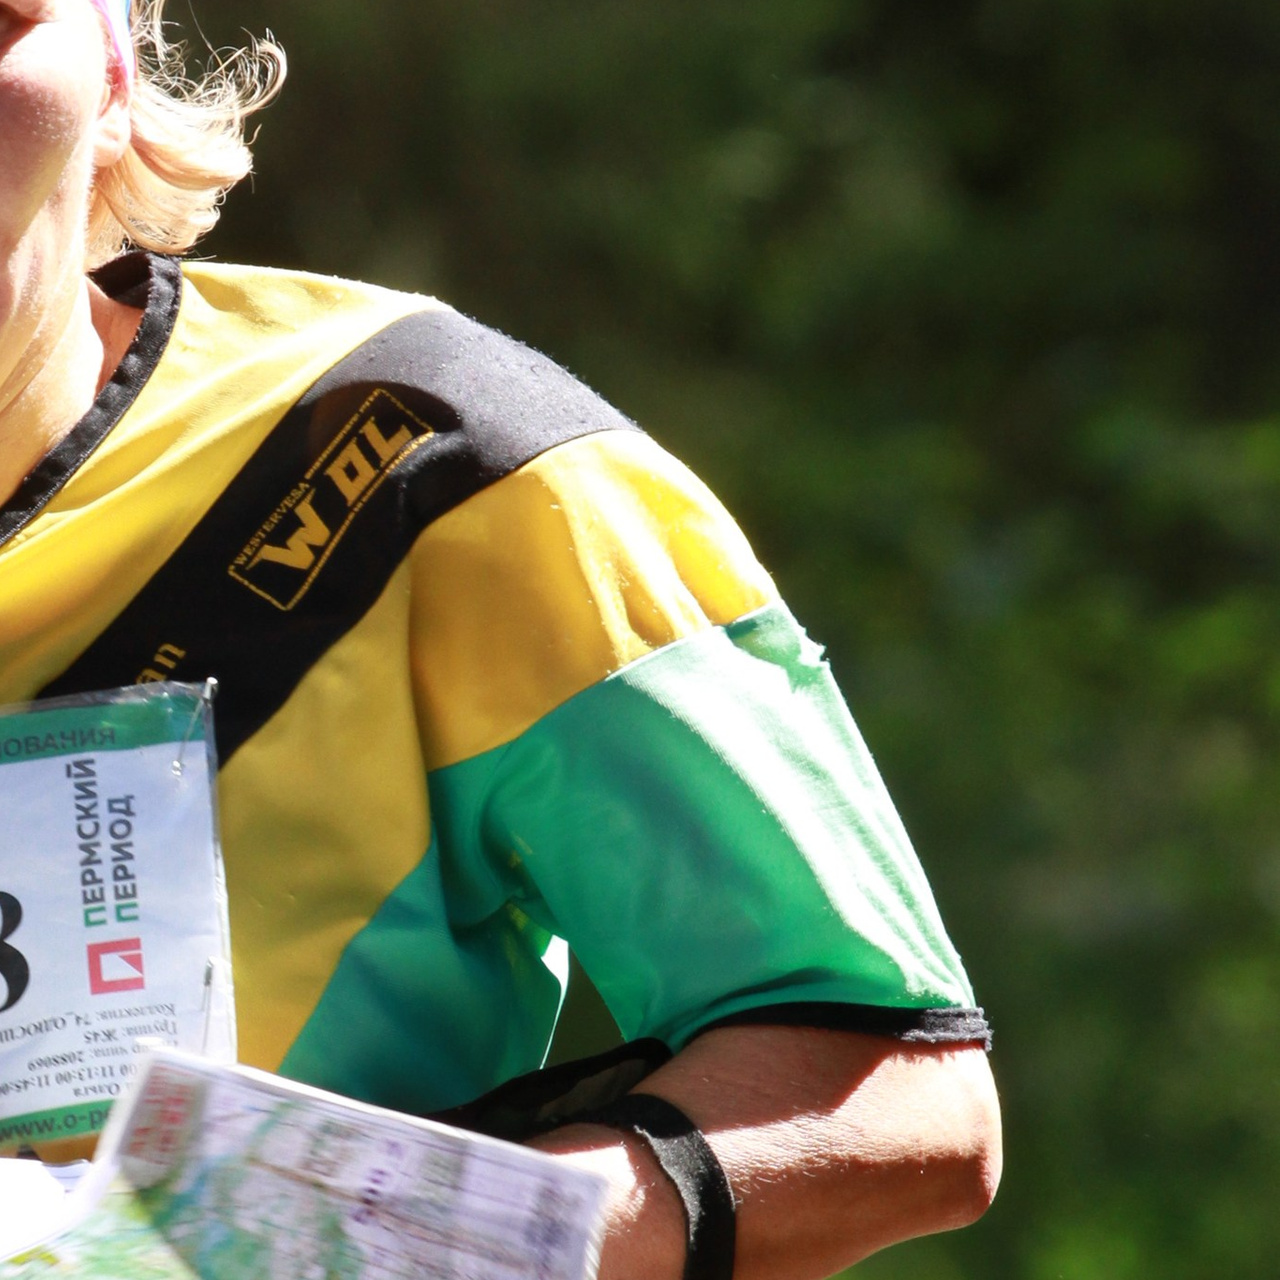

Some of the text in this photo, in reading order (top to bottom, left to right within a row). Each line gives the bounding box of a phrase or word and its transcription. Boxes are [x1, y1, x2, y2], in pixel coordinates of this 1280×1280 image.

[65, 758, 108, 928] ПЕРМСКИЙ
[107, 794, 141, 923] ПЕРИОД
[83, 1028, 120, 1044] Ж45
[27, 1051, 85, 1072] 2088069
[56, 1066, 115, 1086] 11:13:00
[72, 1082, 120, 1098] Ольга
